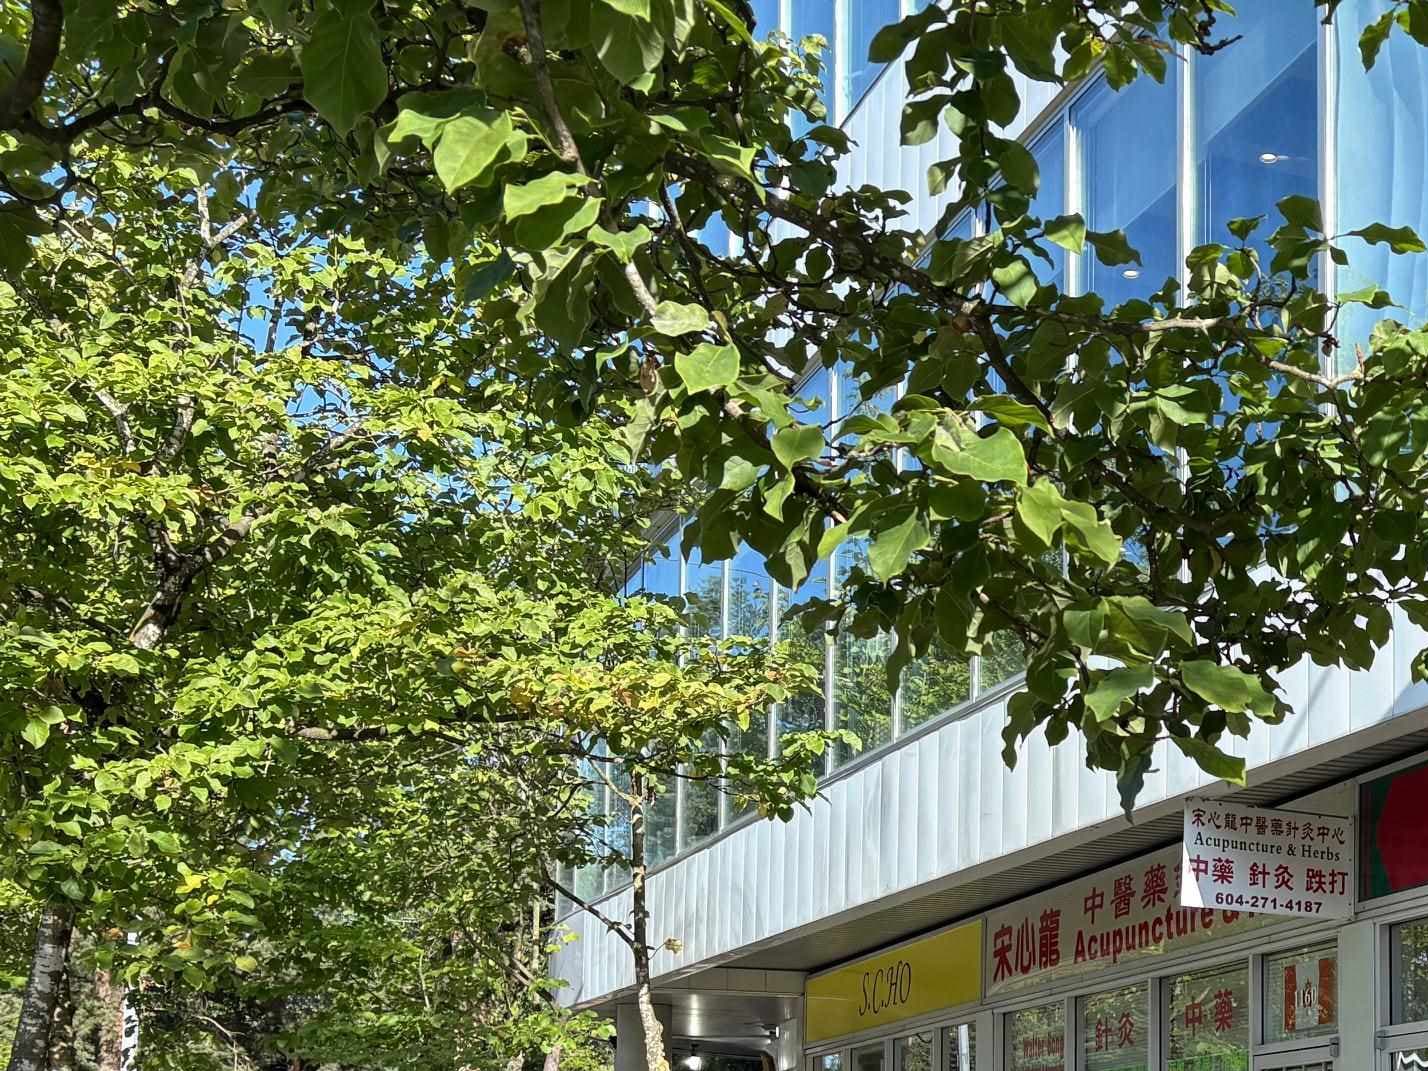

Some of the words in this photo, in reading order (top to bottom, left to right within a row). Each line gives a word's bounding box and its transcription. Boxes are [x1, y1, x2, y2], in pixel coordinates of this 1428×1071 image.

[1194, 832, 1282, 855] Acupuncture
[1287, 843, 1297, 857] &
[1301, 846, 1341, 862] Herbs
[1189, 854, 1235, 885] 中藥
[1248, 862, 1295, 892] 針灸
[1305, 868, 1349, 896] 跌打
[993, 907, 1062, 983] 宋心龍
[1083, 862, 1182, 925] 中醫藥
[1215, 892, 1323, 915] 604-271-4187
[1073, 905, 1213, 965] Acupuncture
[1095, 1011, 1135, 1051] 針灸
[1184, 987, 1233, 1037] 中藥
